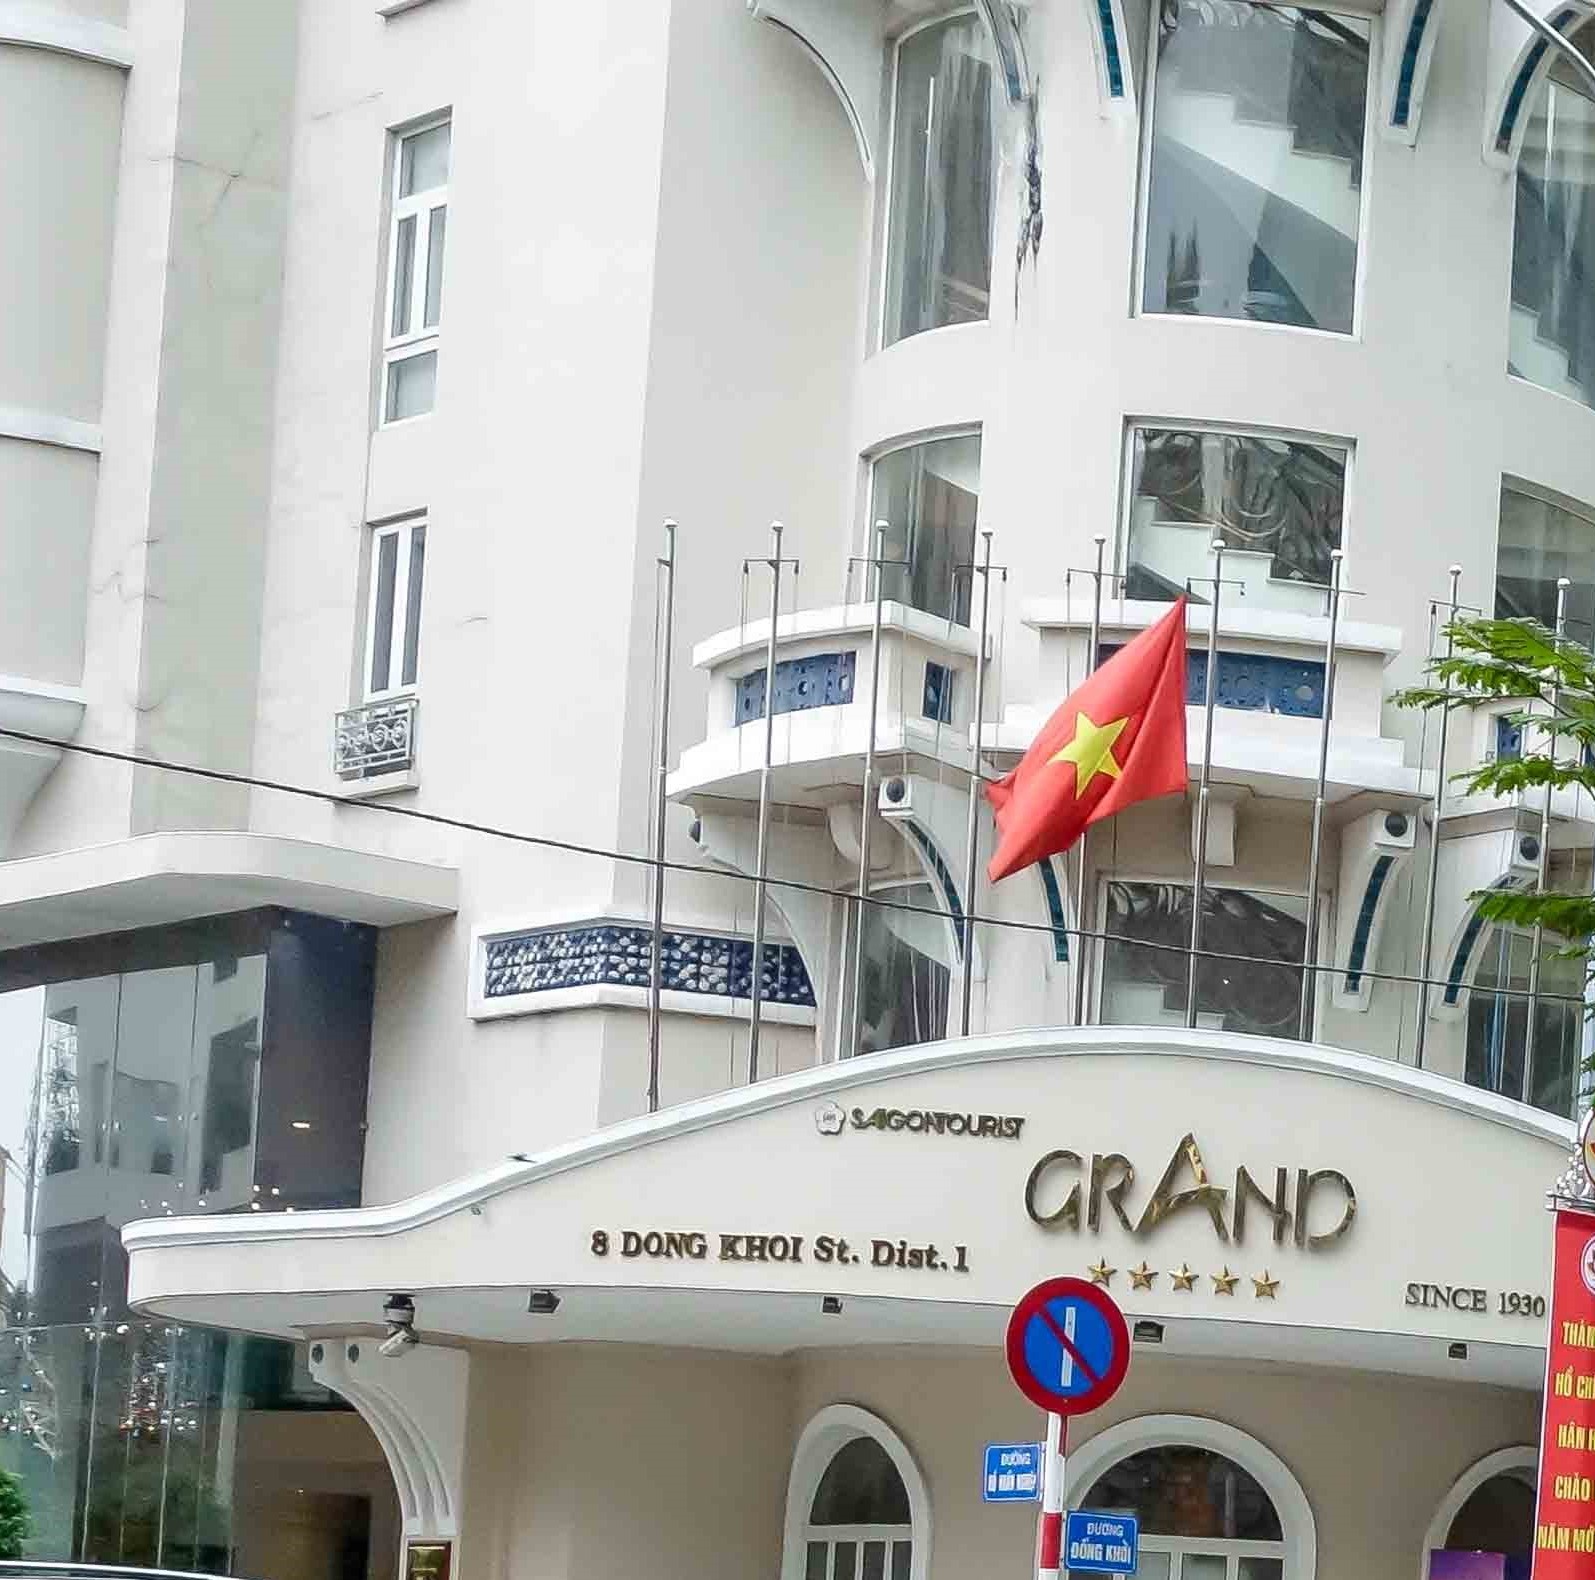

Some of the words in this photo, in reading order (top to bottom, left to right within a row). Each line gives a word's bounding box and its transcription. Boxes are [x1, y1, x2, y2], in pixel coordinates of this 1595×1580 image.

[850, 1108, 1026, 1140] SAIGONTOURIST
[1023, 1132, 1358, 1249] GRAND
[590, 1230, 610, 1257] 8
[620, 1230, 708, 1260] DONG
[718, 1233, 804, 1263] KHOI
[813, 1234, 861, 1265] St.
[1404, 1282, 1488, 1313] SINCE
[1498, 1291, 1545, 1318] 1930
[1555, 1365, 1574, 1396] HỒ
[1537, 1524, 1570, 1551] NĂM
